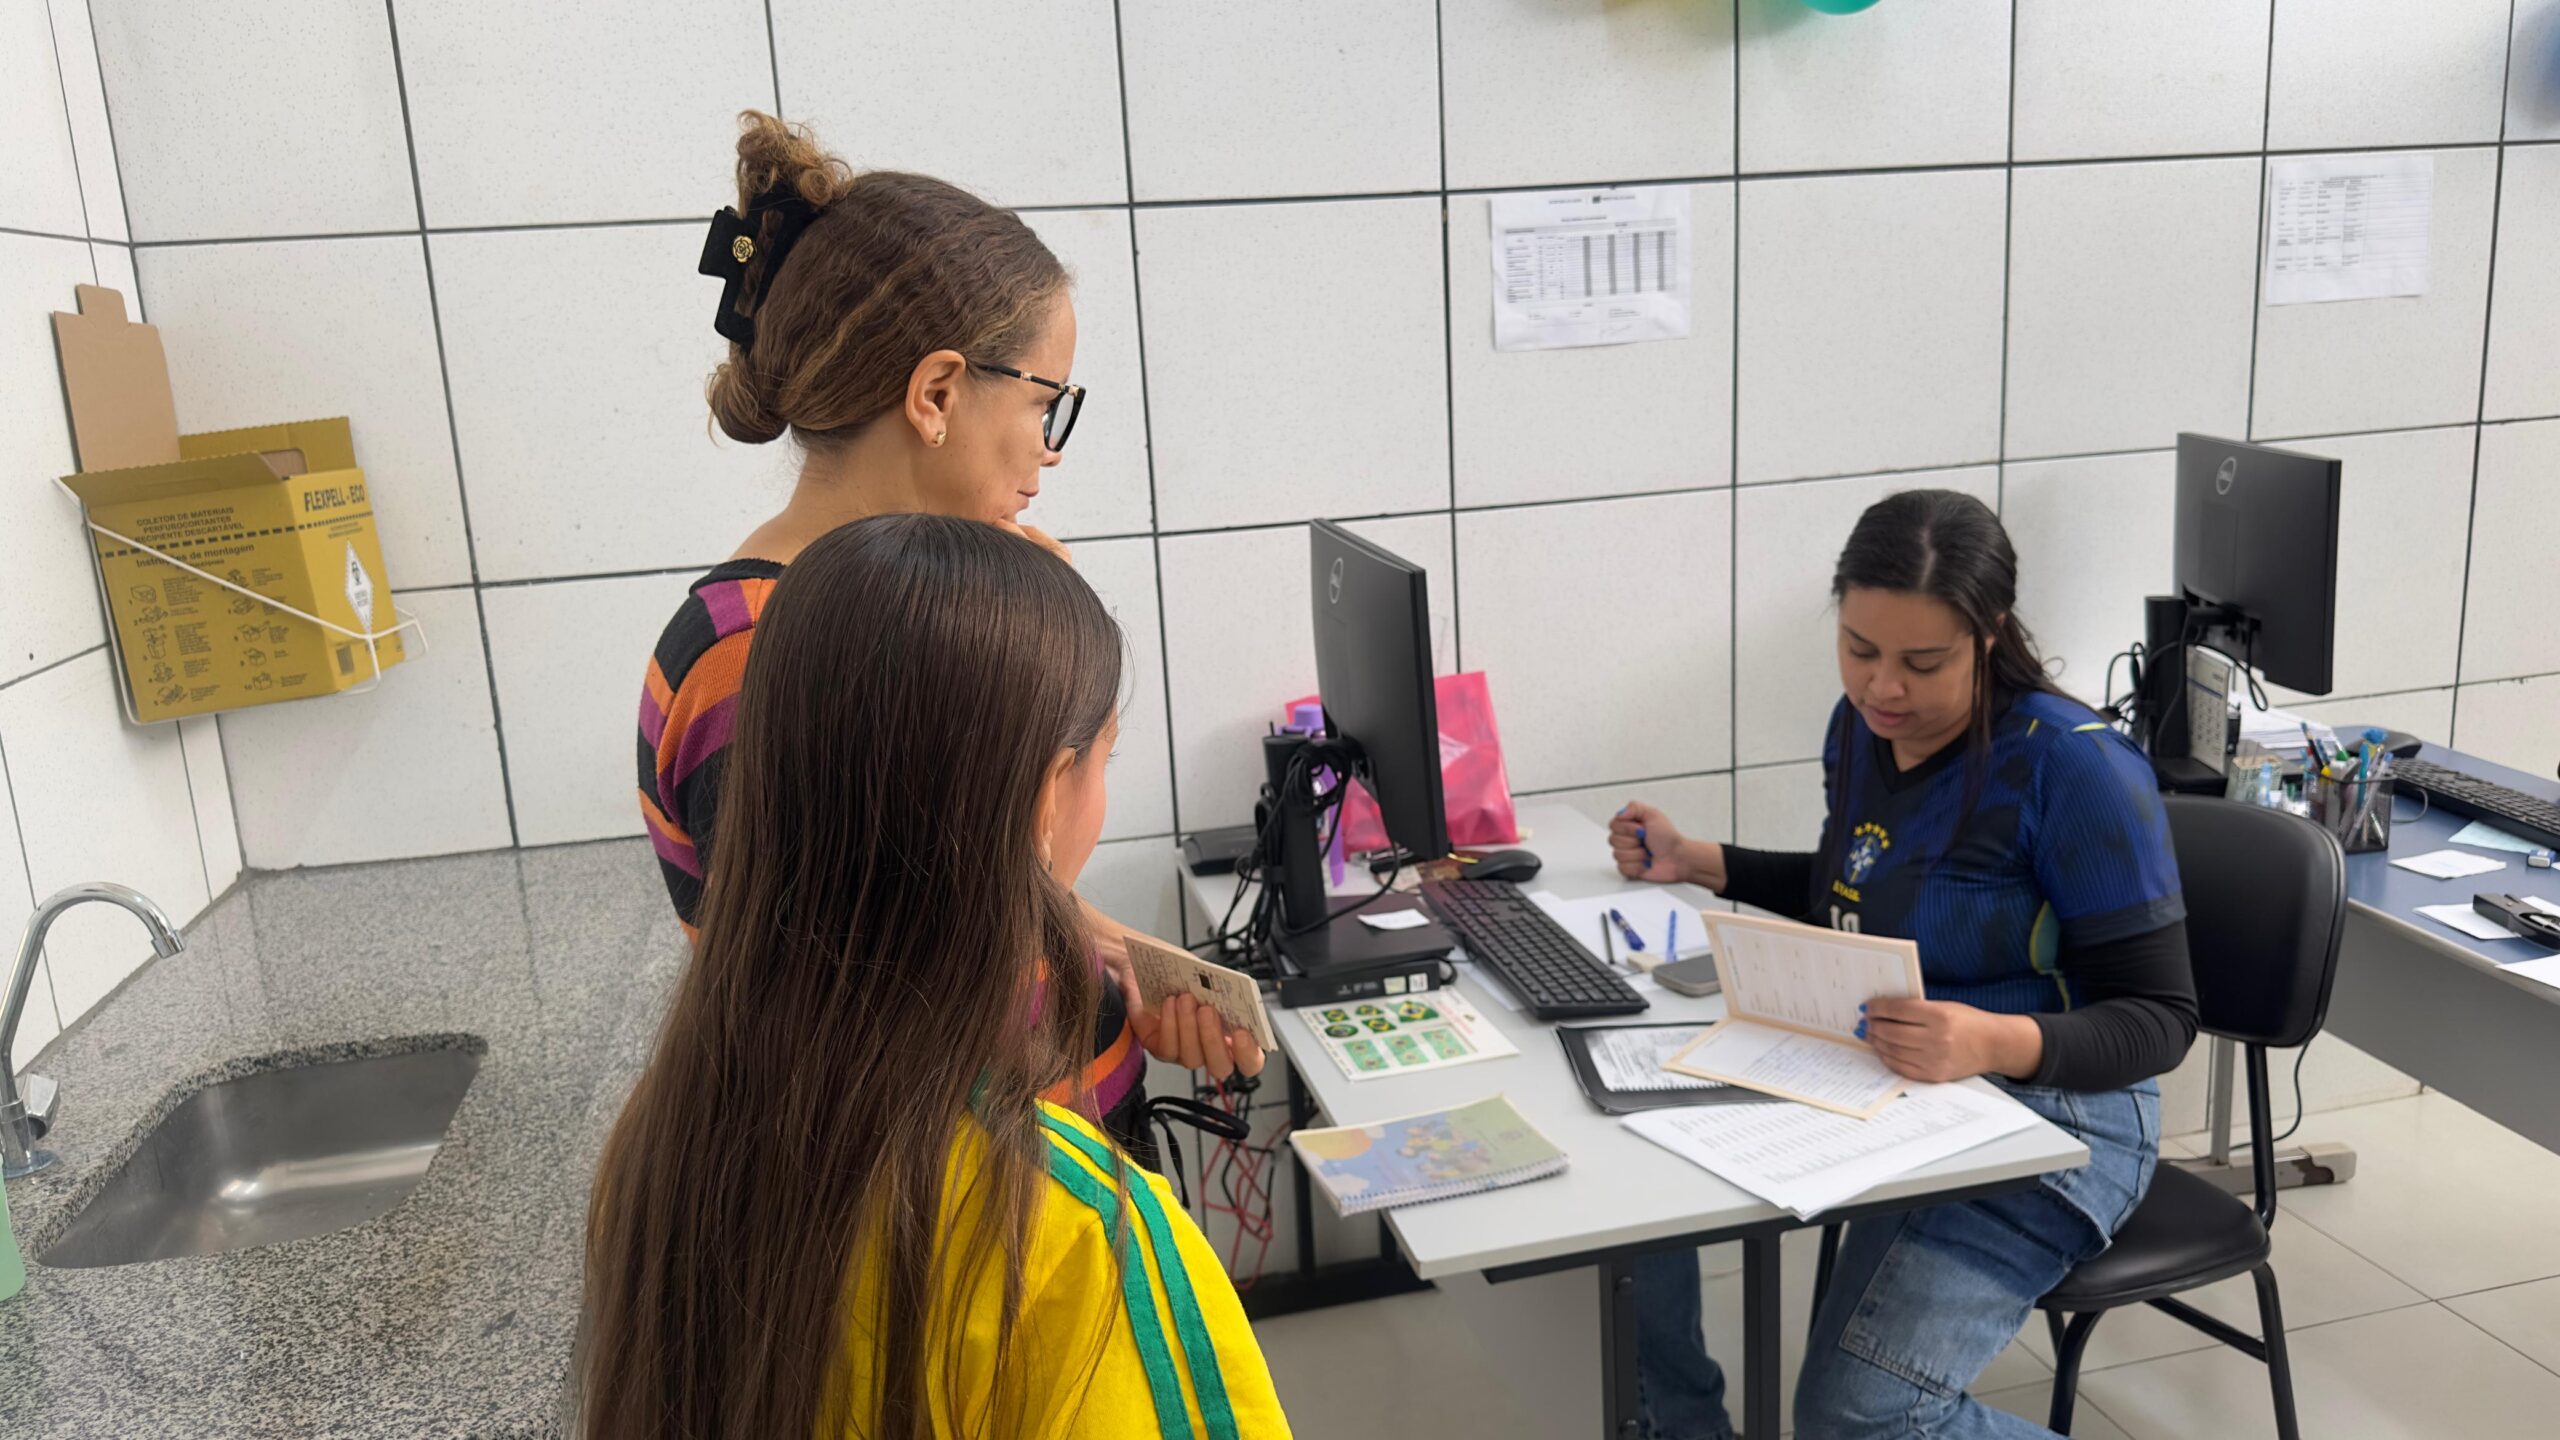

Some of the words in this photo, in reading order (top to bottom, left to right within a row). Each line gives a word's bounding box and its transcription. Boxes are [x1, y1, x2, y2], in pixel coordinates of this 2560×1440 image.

[304, 487, 346, 512] FLEXPELL
[349, 484, 365, 504] ECO
[136, 514, 176, 526] COLETOR
[177, 511, 189, 520] DE
[190, 507, 234, 518] MATERIAIS
[143, 515, 232, 533] PERFUROCORTANTES
[184, 522, 244, 536] DESCARTÁVEL
[190, 551, 201, 559] de
[204, 544, 255, 556] montagem
